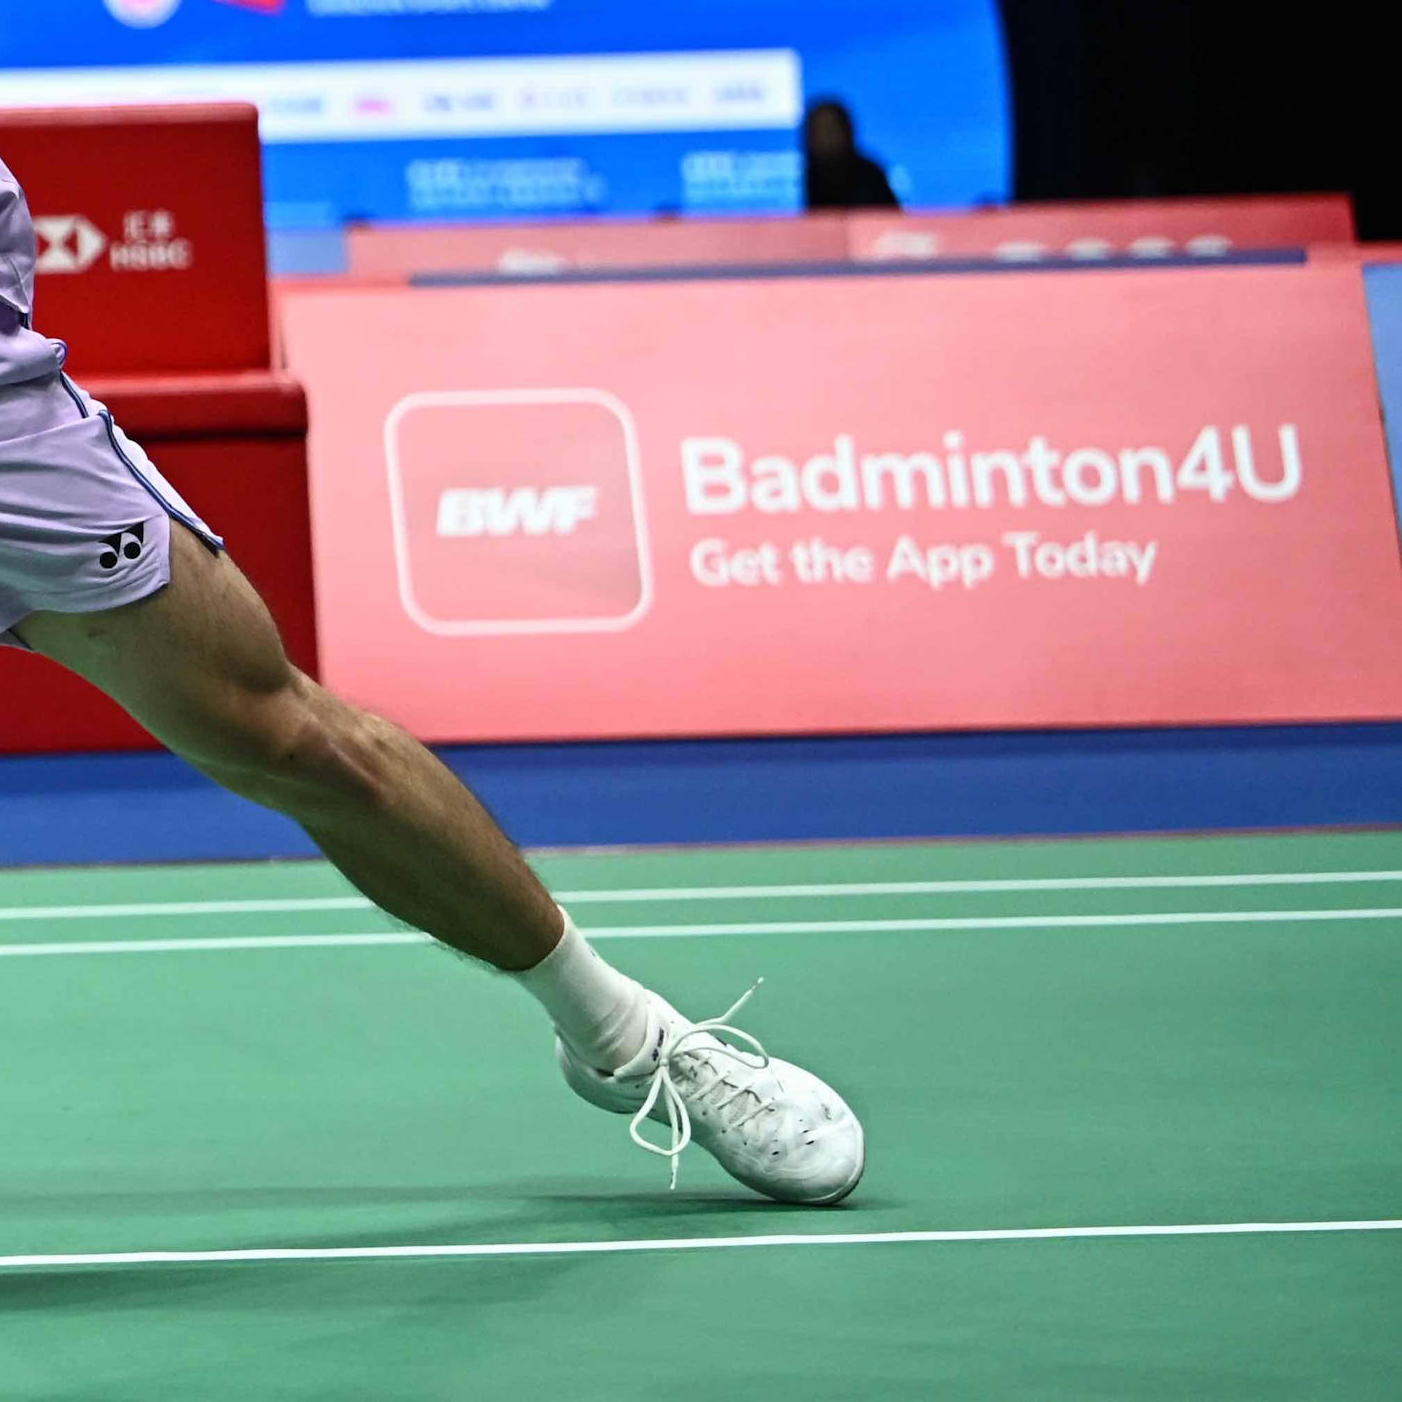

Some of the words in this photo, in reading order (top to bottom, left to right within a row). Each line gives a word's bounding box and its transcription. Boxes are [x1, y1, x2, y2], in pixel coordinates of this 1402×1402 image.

[108, 238, 193, 272] HSBC
[680, 425, 1303, 516] Badminton4U
[435, 483, 600, 538] BWF
[689, 537, 783, 587] Get
[790, 535, 876, 582] the
[886, 533, 996, 590] App
[1002, 528, 1158, 586] Today
